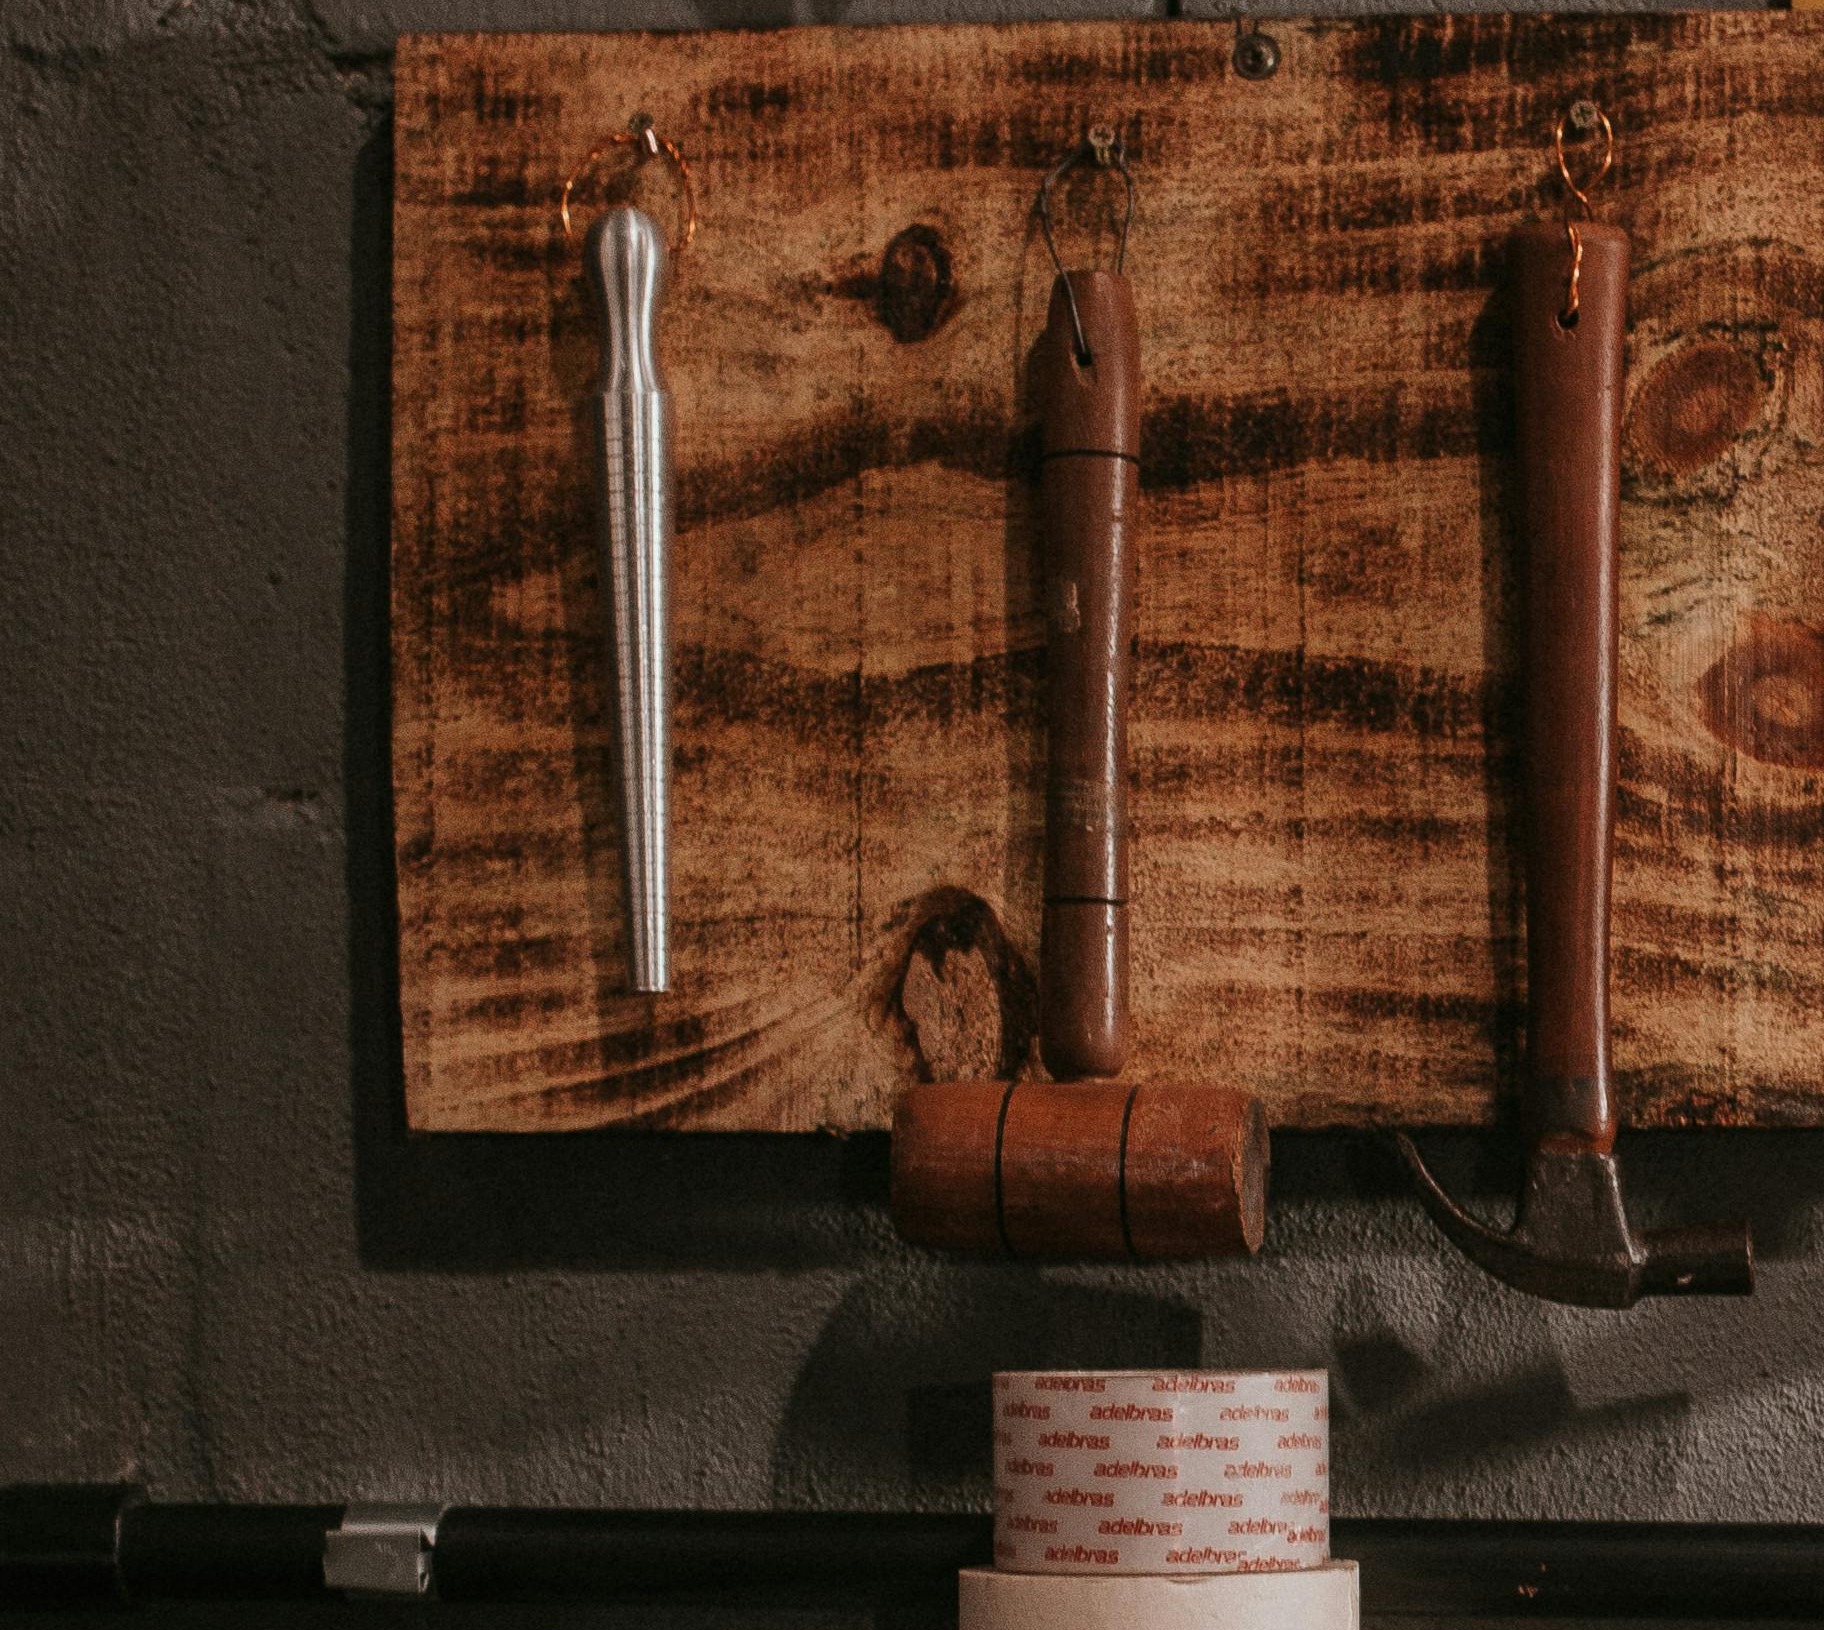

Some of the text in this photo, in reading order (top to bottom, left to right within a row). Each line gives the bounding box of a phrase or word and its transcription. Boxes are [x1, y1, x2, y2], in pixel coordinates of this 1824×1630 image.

[1152, 1373, 1236, 1393] adelbras
[1089, 1402, 1175, 1421] adelbras
[1156, 1432, 1240, 1451] adelbras
[1093, 1459, 1179, 1479] adelbras
[1161, 1488, 1244, 1508] adelbras
[1098, 1516, 1183, 1536] adelbras
